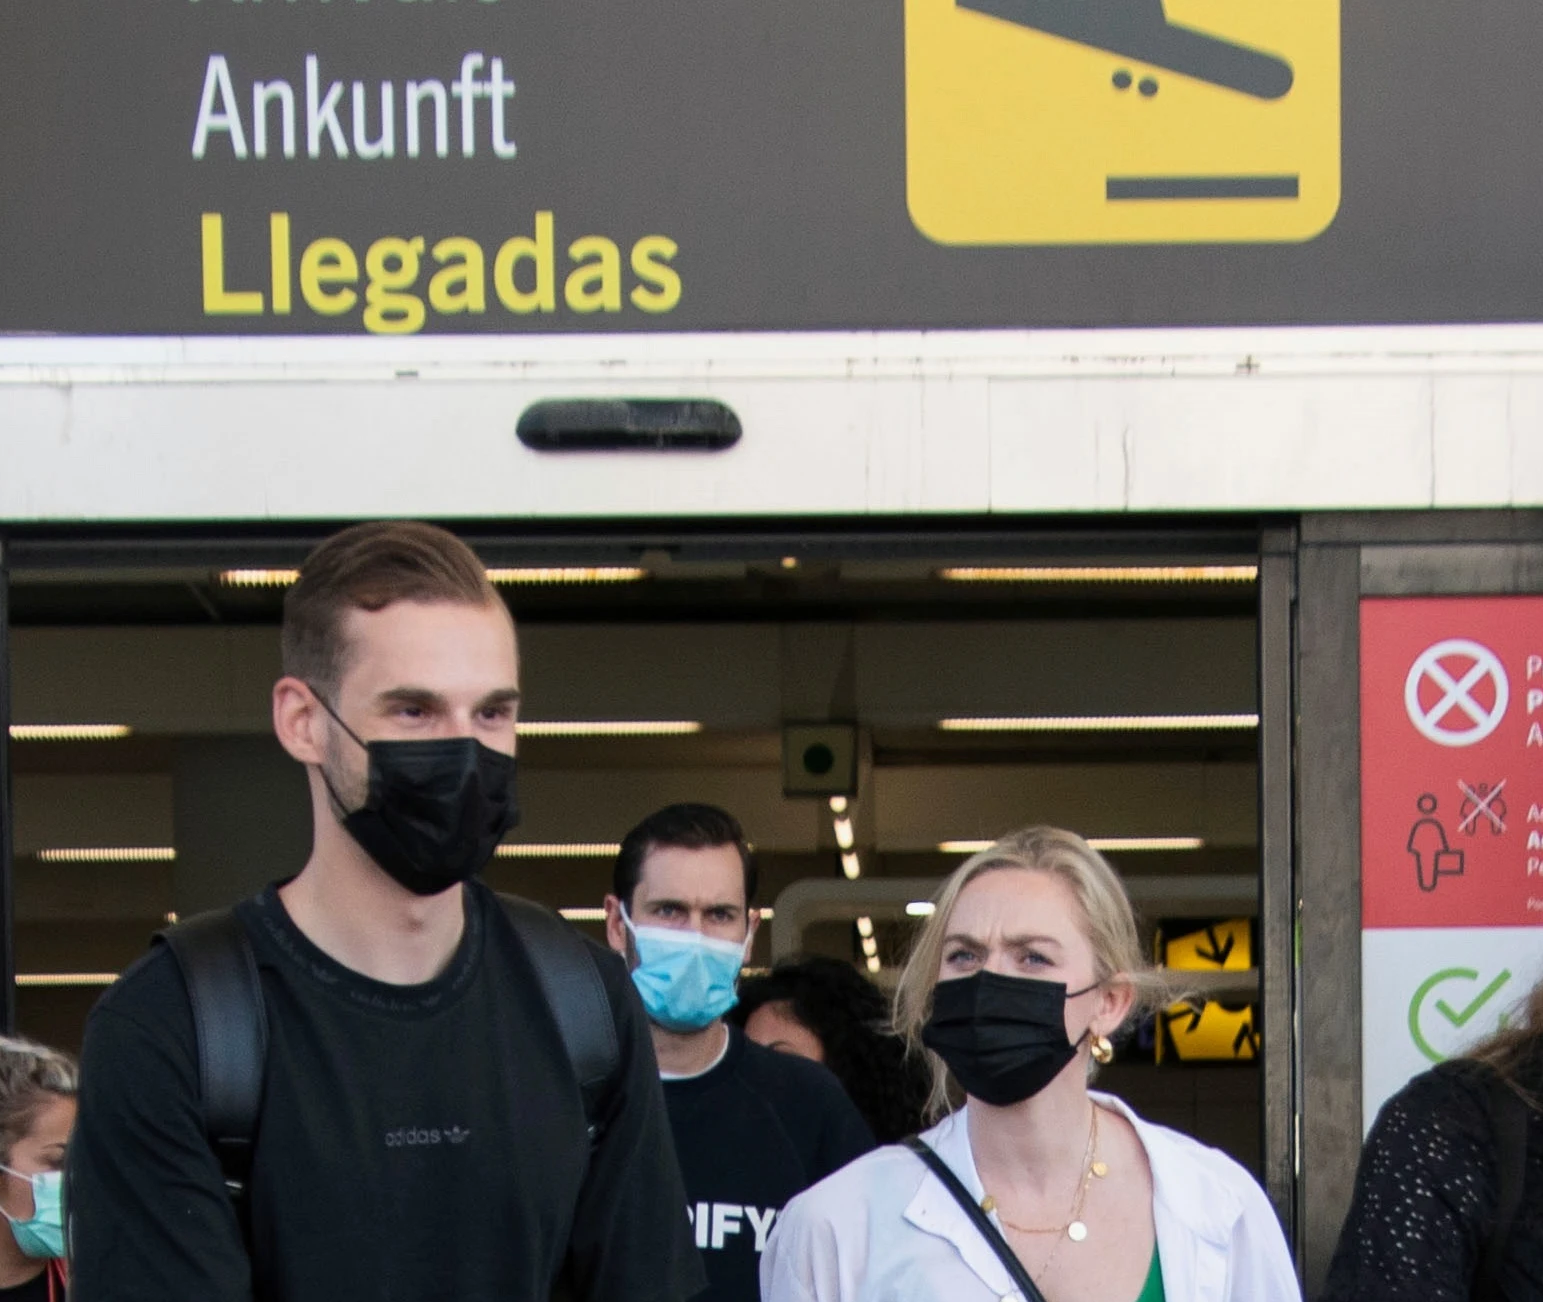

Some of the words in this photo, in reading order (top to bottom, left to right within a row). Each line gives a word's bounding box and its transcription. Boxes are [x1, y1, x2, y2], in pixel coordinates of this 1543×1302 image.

[192, 52, 517, 159] Ankunft
[200, 209, 683, 335] Llegadas
[384, 1127, 441, 1147] adidas
